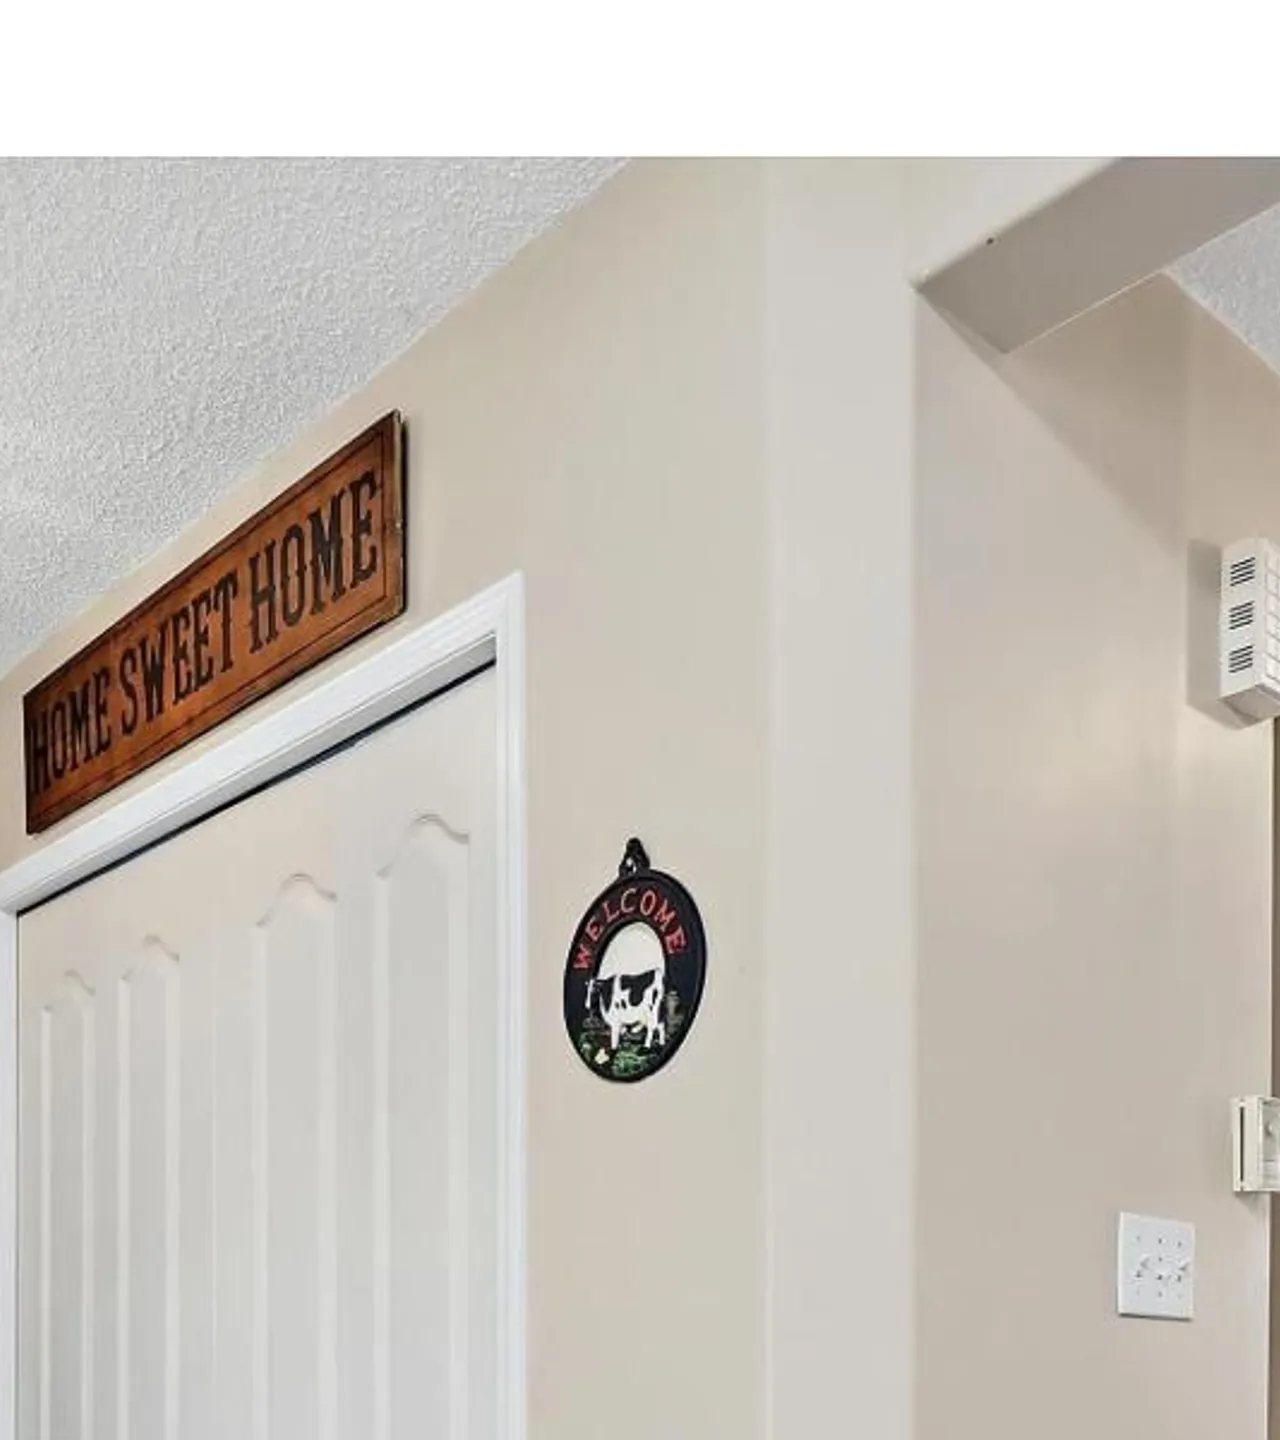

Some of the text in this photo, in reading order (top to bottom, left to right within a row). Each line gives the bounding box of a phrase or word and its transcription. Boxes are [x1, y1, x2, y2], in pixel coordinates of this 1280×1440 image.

[30, 468, 378, 796] HOME SWEET HOME
[573, 887, 688, 970] WELCOME
